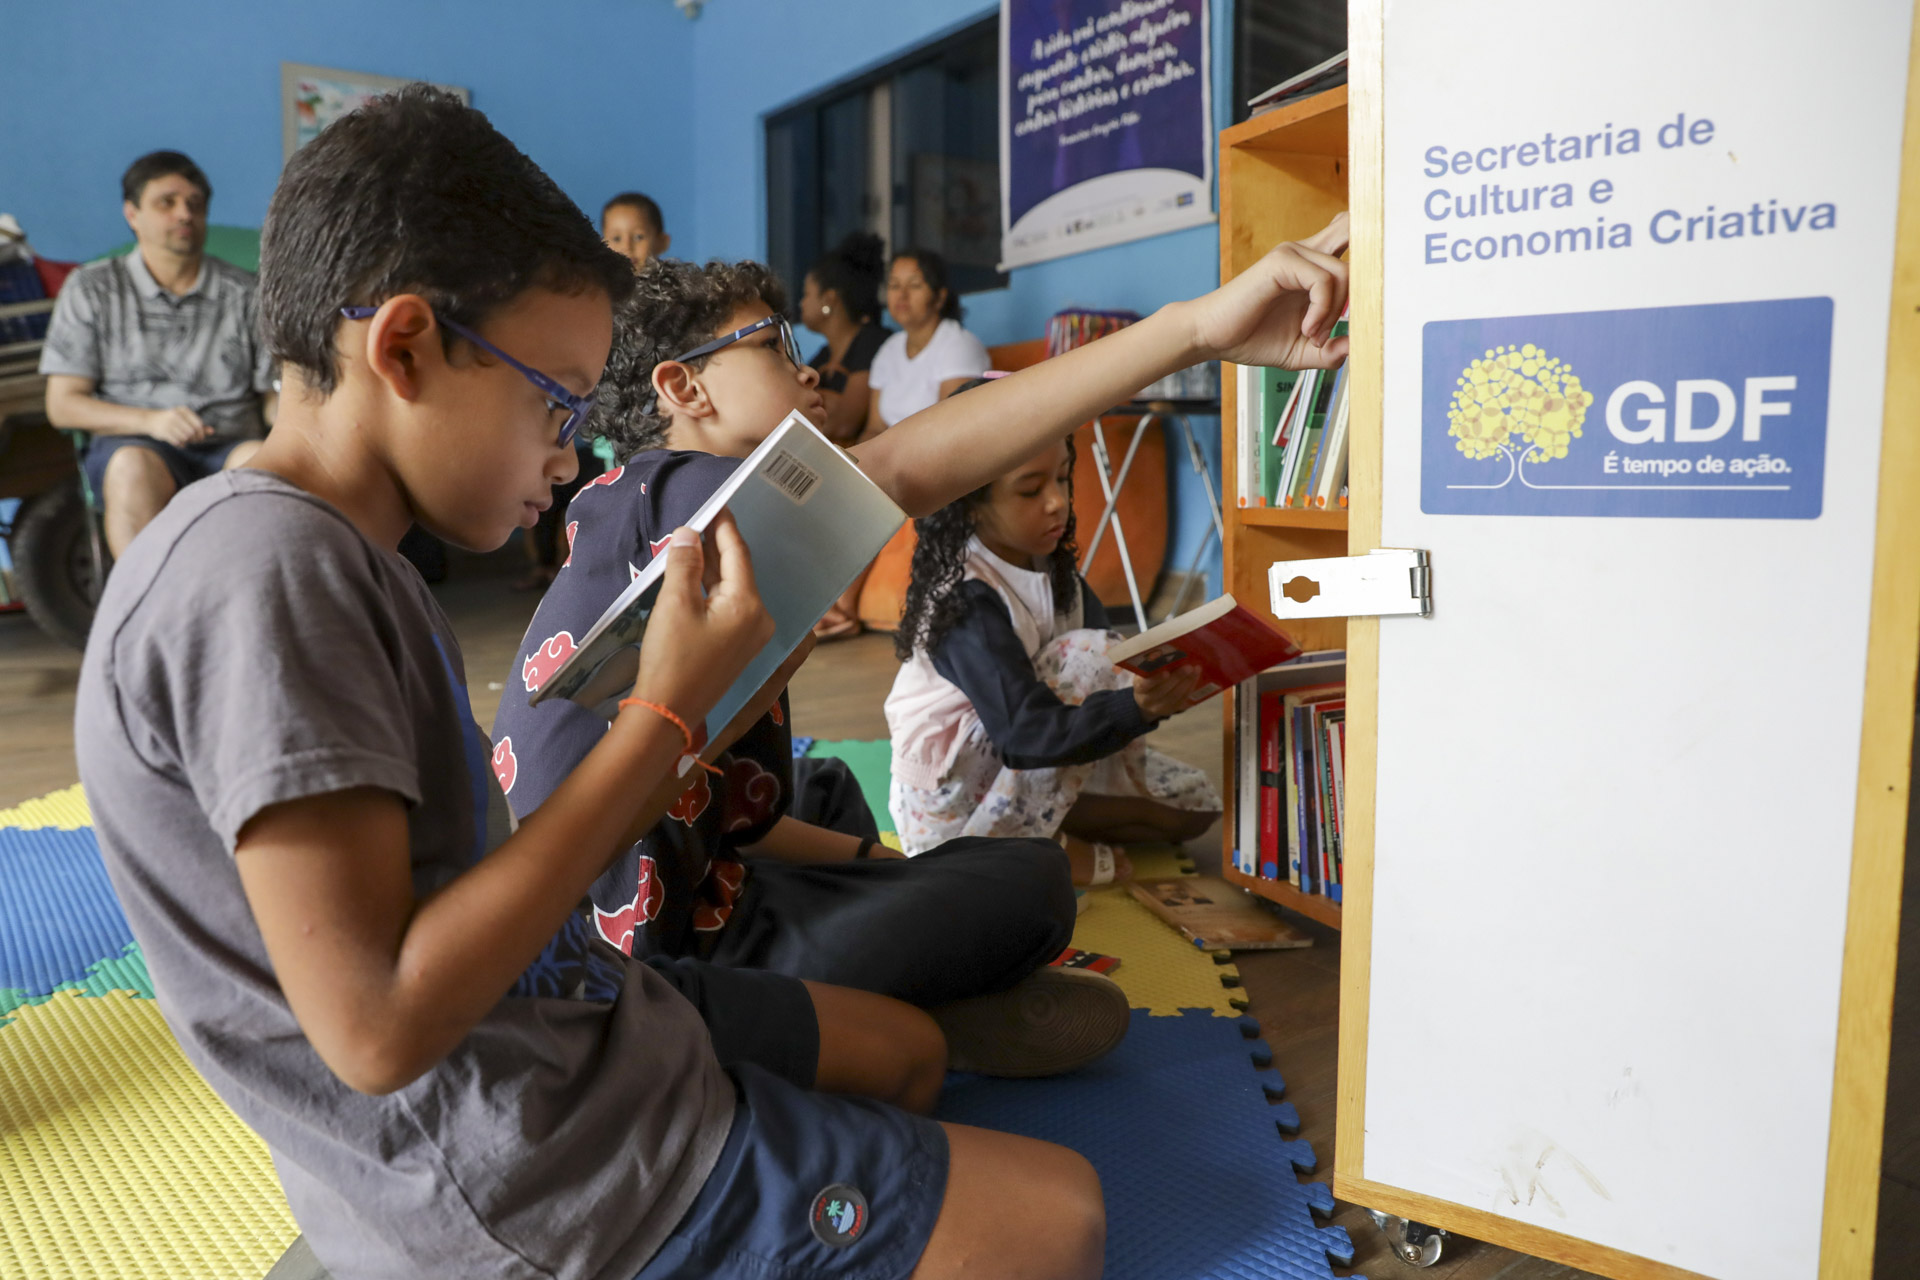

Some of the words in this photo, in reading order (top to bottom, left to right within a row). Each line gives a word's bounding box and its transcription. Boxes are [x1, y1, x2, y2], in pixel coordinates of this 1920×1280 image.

[1423, 123, 1641, 178] Secretaria
[1656, 113, 1716, 150] de
[1423, 184, 1575, 221] Cultura
[1588, 178, 1614, 204] e
[1424, 217, 1633, 265] Economia
[1648, 200, 1838, 244] Criativa
[1605, 375, 1797, 444] GDF
[1603, 450, 1619, 474] É
[1622, 456, 1692, 478] tempo
[1696, 455, 1725, 474] de
[1728, 453, 1793, 478] ação.
